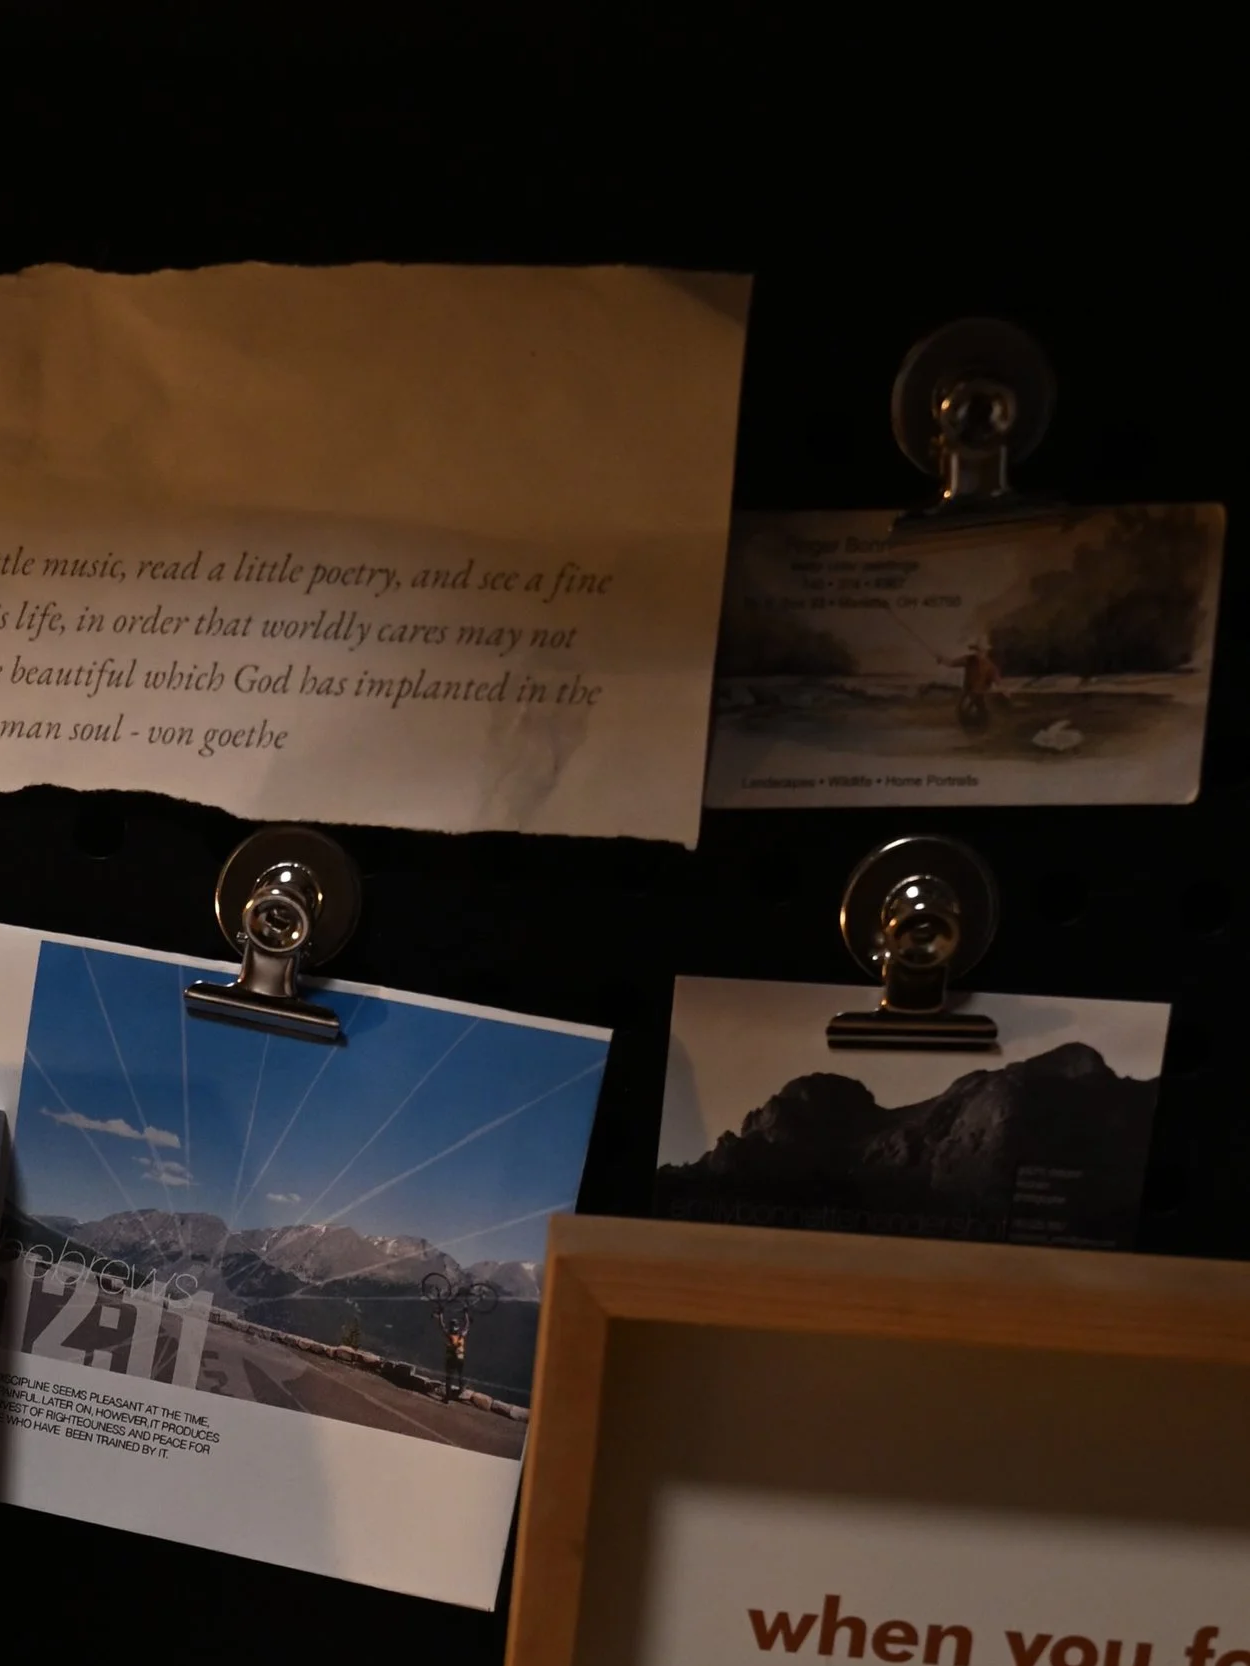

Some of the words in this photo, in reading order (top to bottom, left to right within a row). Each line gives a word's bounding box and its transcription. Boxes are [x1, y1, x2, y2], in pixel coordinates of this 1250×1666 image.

[43, 553, 126, 582] music,
[137, 550, 203, 580] read
[207, 563, 225, 581] a
[234, 551, 303, 583] little
[305, 564, 401, 597] poetry,
[411, 559, 474, 589] and
[478, 572, 519, 591] see
[524, 574, 544, 591] a
[543, 562, 613, 603] fine
[16, 601, 65, 641] life,
[76, 607, 104, 632] in
[113, 605, 189, 634] order
[195, 606, 252, 636] that
[262, 610, 371, 651] worldly
[378, 625, 448, 644] cares
[457, 627, 522, 657] may
[530, 628, 577, 648] not
[11, 655, 137, 698] beautiful
[144, 661, 224, 691] which
[234, 665, 293, 694] God
[300, 665, 347, 696] has
[355, 669, 510, 709] implanted
[517, 676, 546, 703] in
[556, 675, 601, 705] the
[69, 713, 124, 742] soul
[148, 727, 193, 745] von
[198, 719, 288, 757] goethe
[51, 1384, 88, 1400] SEEMS
[88, 1392, 144, 1412] PLEASANT
[144, 1405, 160, 1415] AT
[159, 1408, 182, 1420] THE
[181, 1413, 211, 1427] TIME,
[74, 1404, 95, 1415] ON,
[160, 1422, 221, 1443] PRODUCES
[5, 1415, 33, 1428] WHO
[32, 1421, 61, 1434] HAVE
[64, 1428, 94, 1441] BEEN
[94, 1435, 140, 1452] TRAINED
[140, 1445, 157, 1455] BY
[157, 1448, 170, 1458] IT.
[28, 1406, 45, 1417] OF
[126, 1428, 151, 1441] AND
[151, 1434, 188, 1449] PEACE
[187, 1442, 211, 1454] FOR
